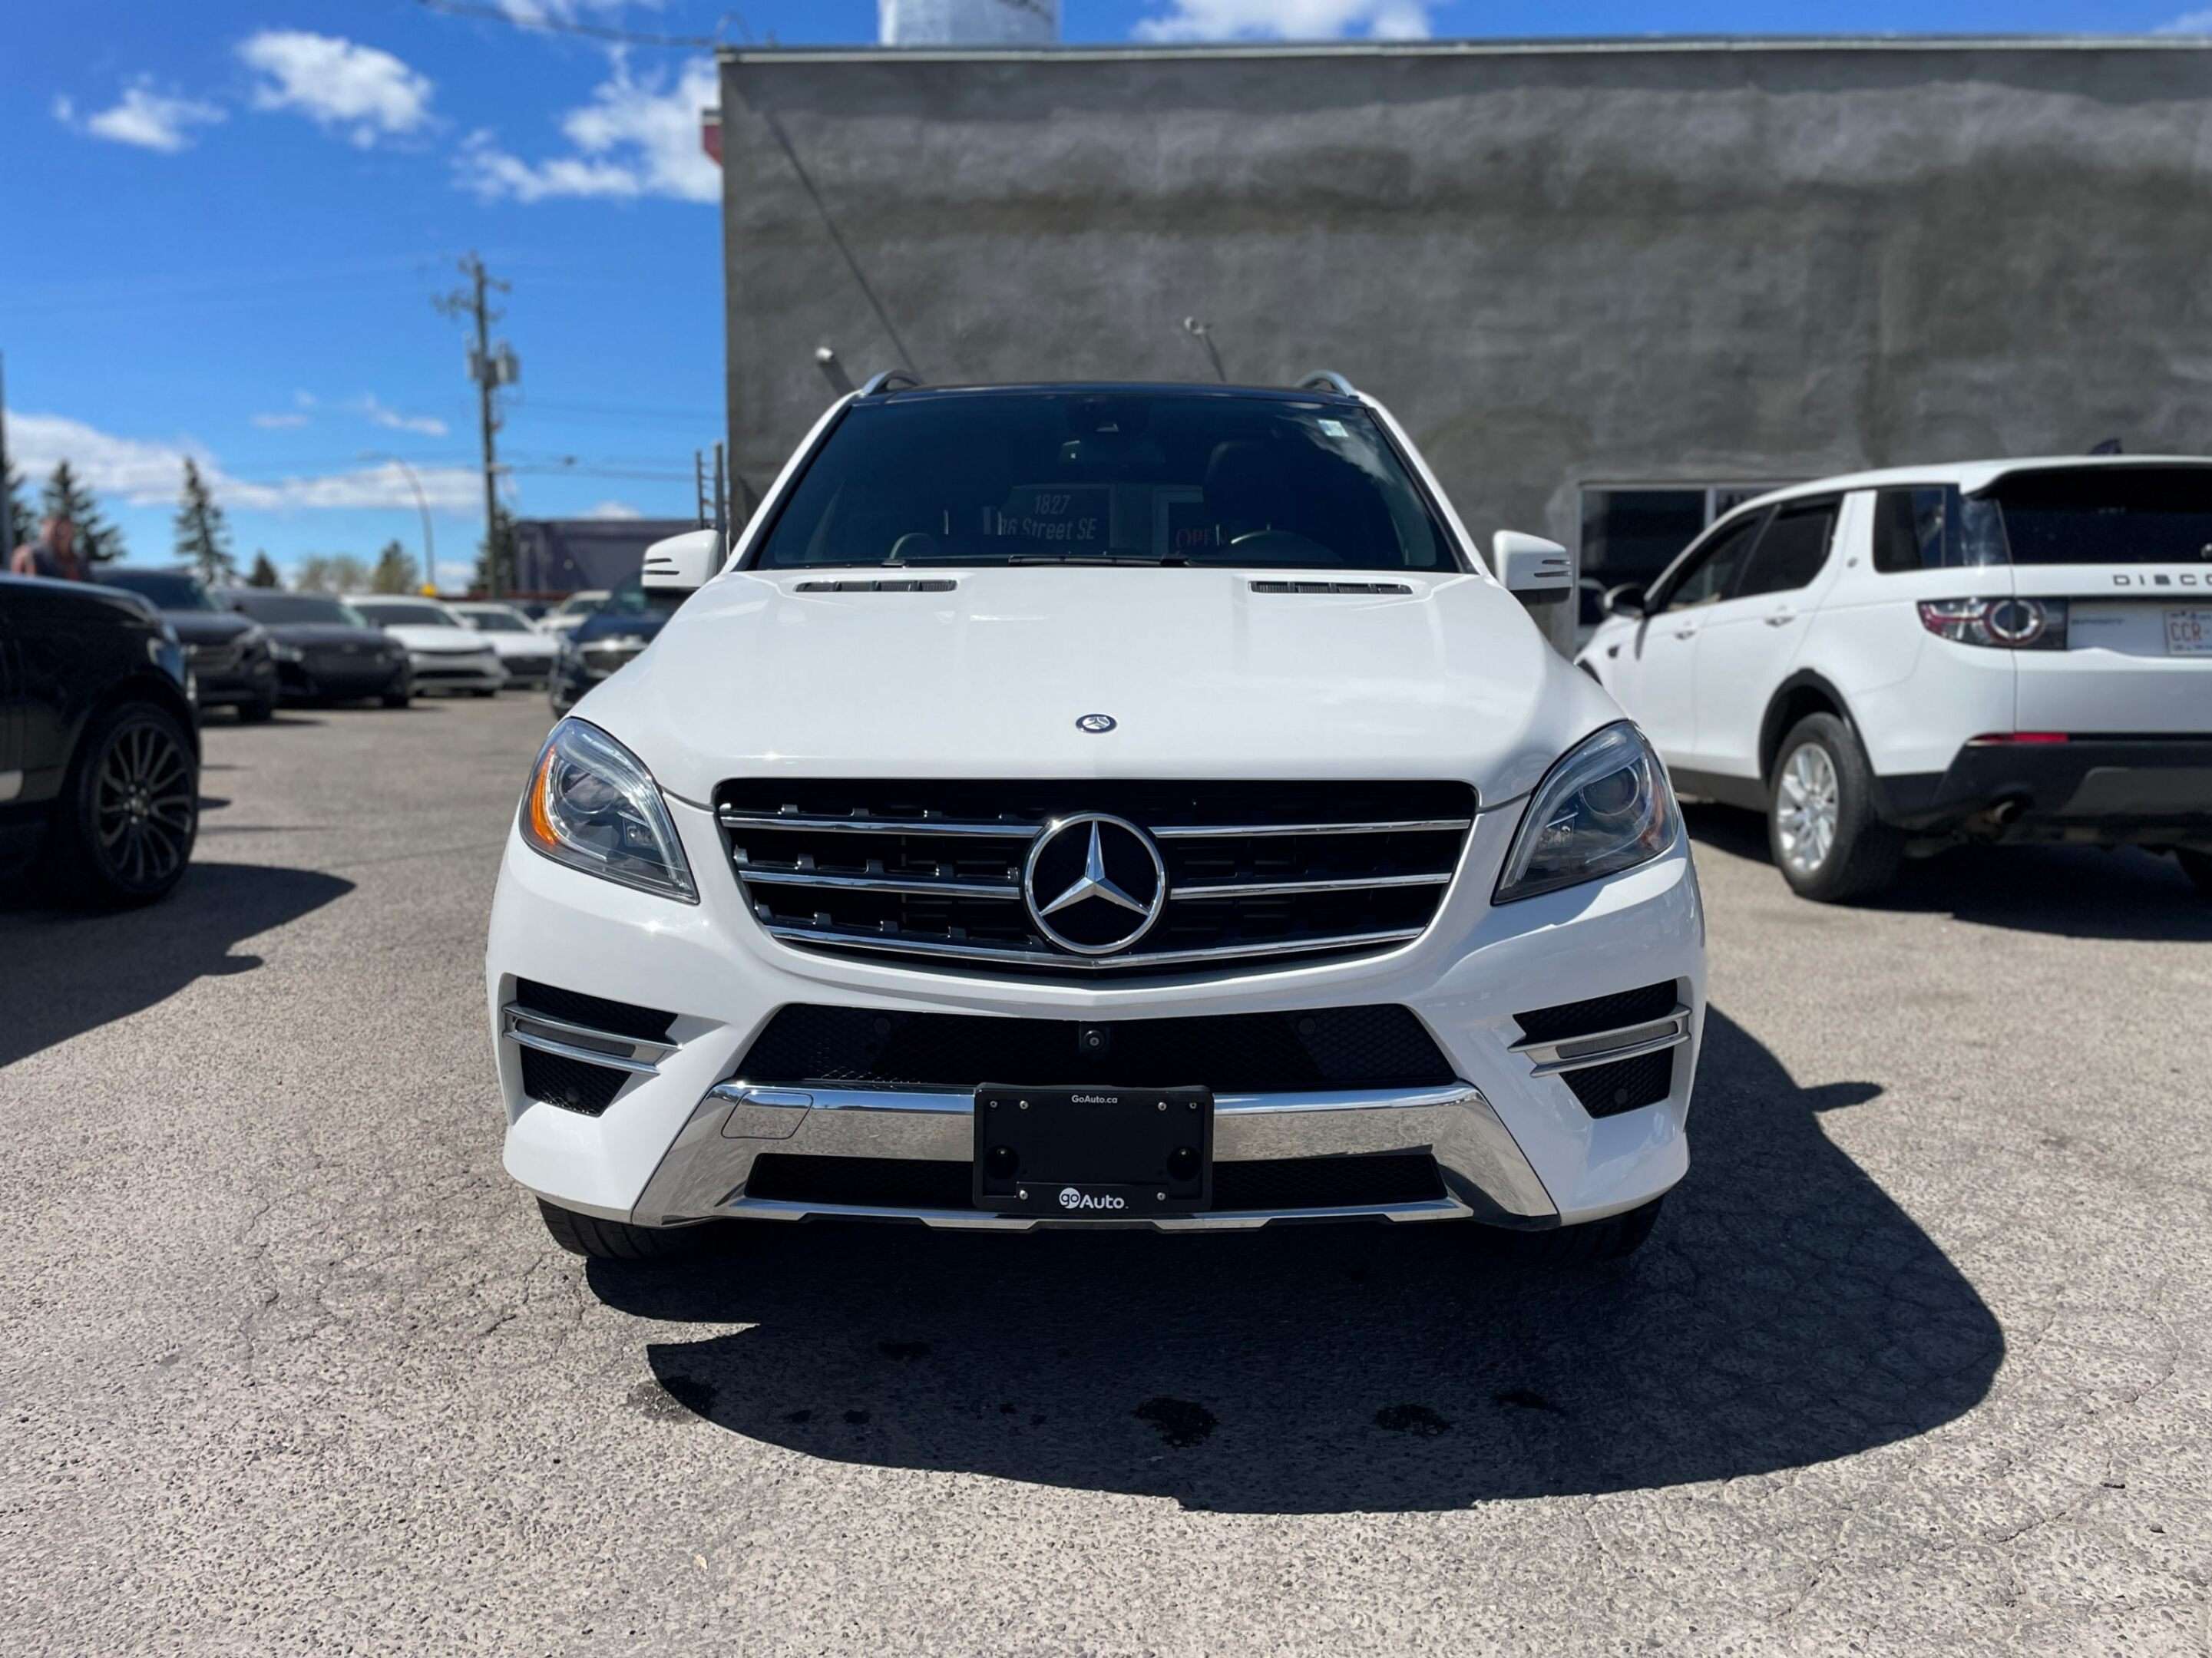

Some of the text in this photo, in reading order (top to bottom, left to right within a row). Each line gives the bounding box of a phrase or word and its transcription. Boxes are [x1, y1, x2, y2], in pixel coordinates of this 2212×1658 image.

[1033, 494, 1072, 515] 1827
[1022, 517, 1073, 540] Street
[1076, 517, 1098, 540] SE
[1071, 1095, 1118, 1104] GoAuto.ca
